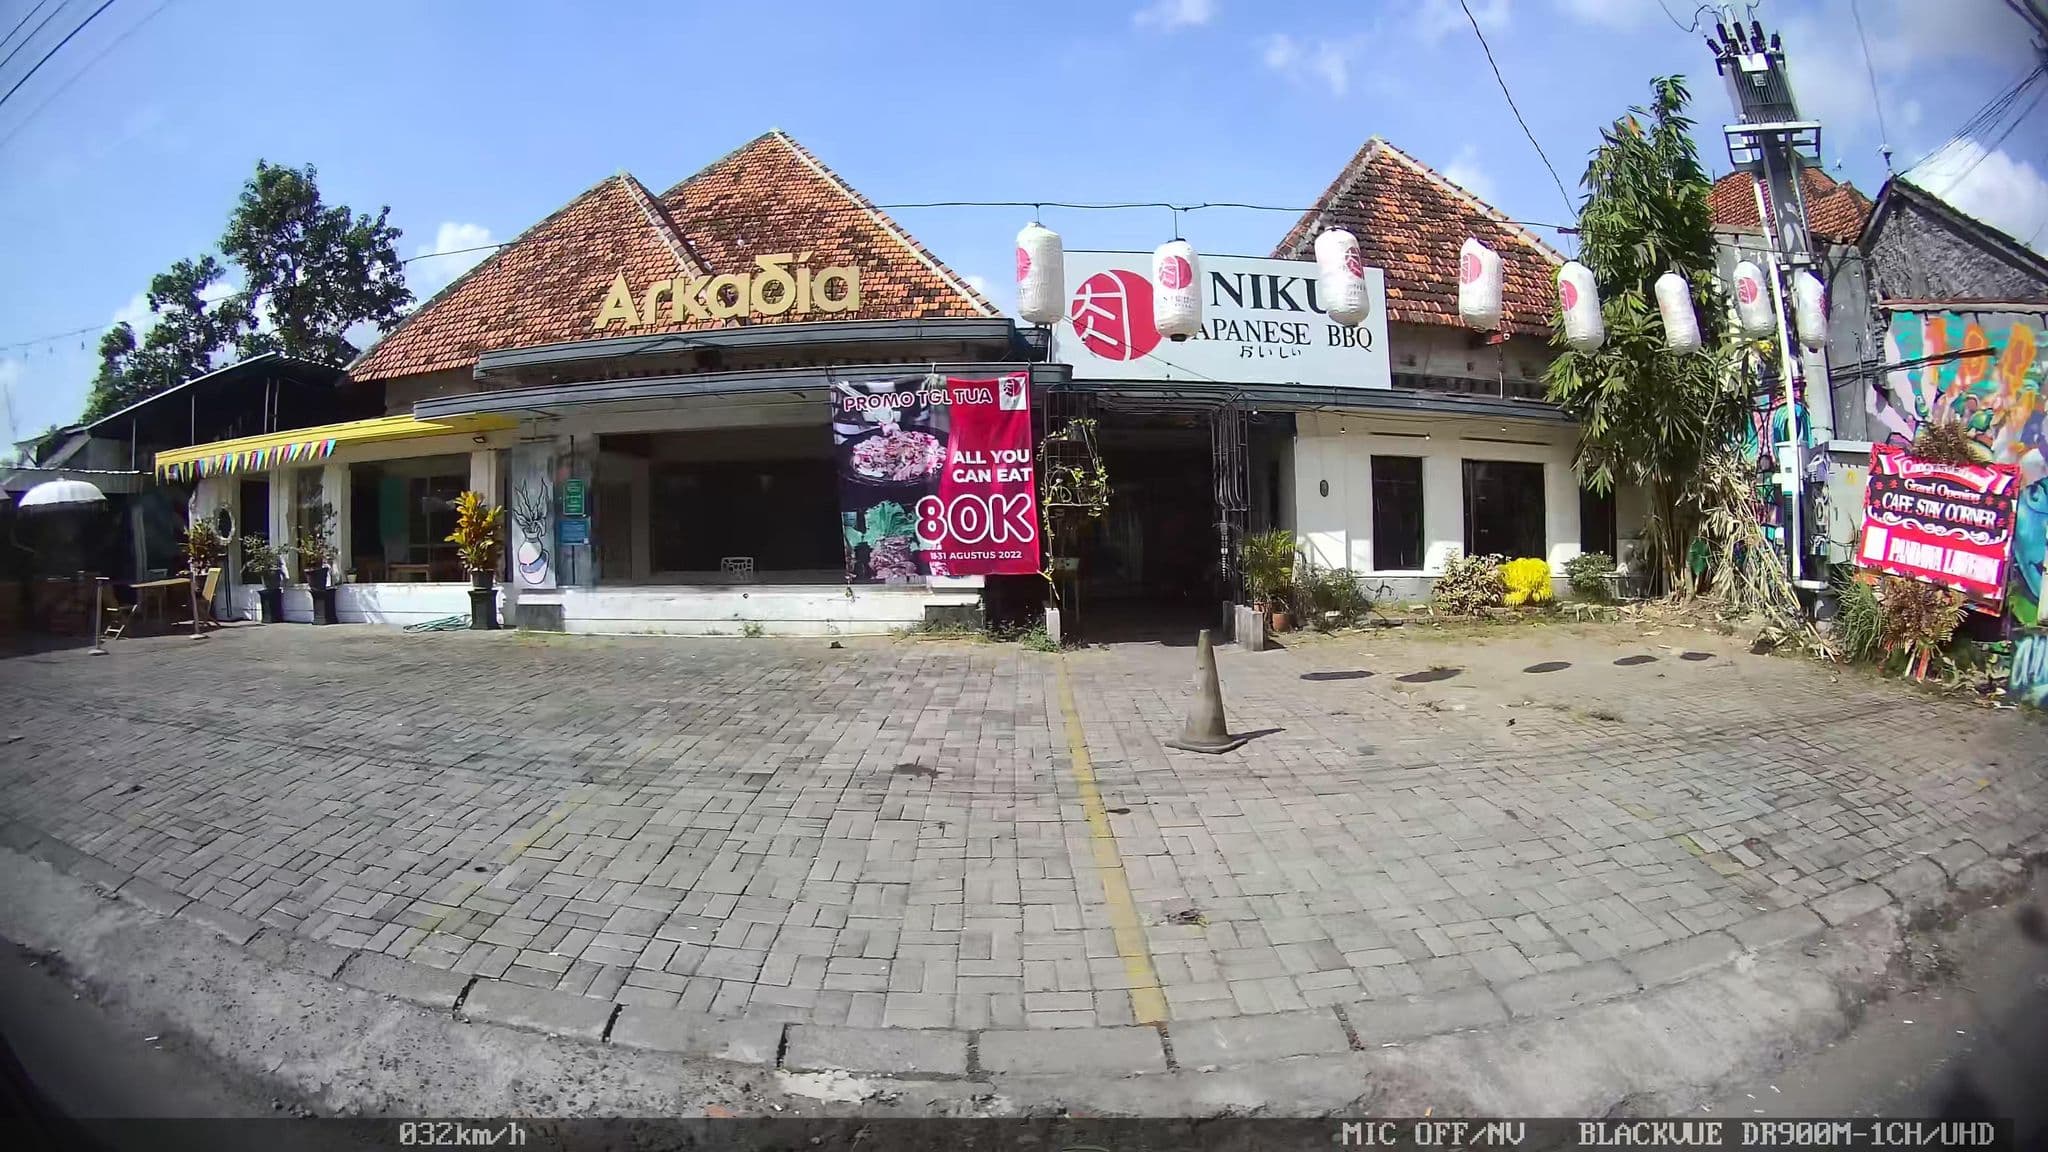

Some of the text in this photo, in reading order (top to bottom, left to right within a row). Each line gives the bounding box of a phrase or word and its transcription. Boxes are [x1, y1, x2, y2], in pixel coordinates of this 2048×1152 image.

[592, 250, 861, 330] Arkadia
[1191, 318, 1373, 353] APANESE BBQ
[1240, 345, 1302, 359] おいしい
[843, 389, 992, 412] PROMO TGL TUA
[953, 449, 1030, 465] ALL YOU
[953, 468, 1032, 484] CAN EAT
[1904, 478, 1982, 504] Grand Opening
[915, 493, 1035, 544] 80K
[1881, 492, 1997, 529] CAFE STAY CORNER
[949, 551, 996, 560] AGUSTUS
[998, 551, 1022, 559] 2022
